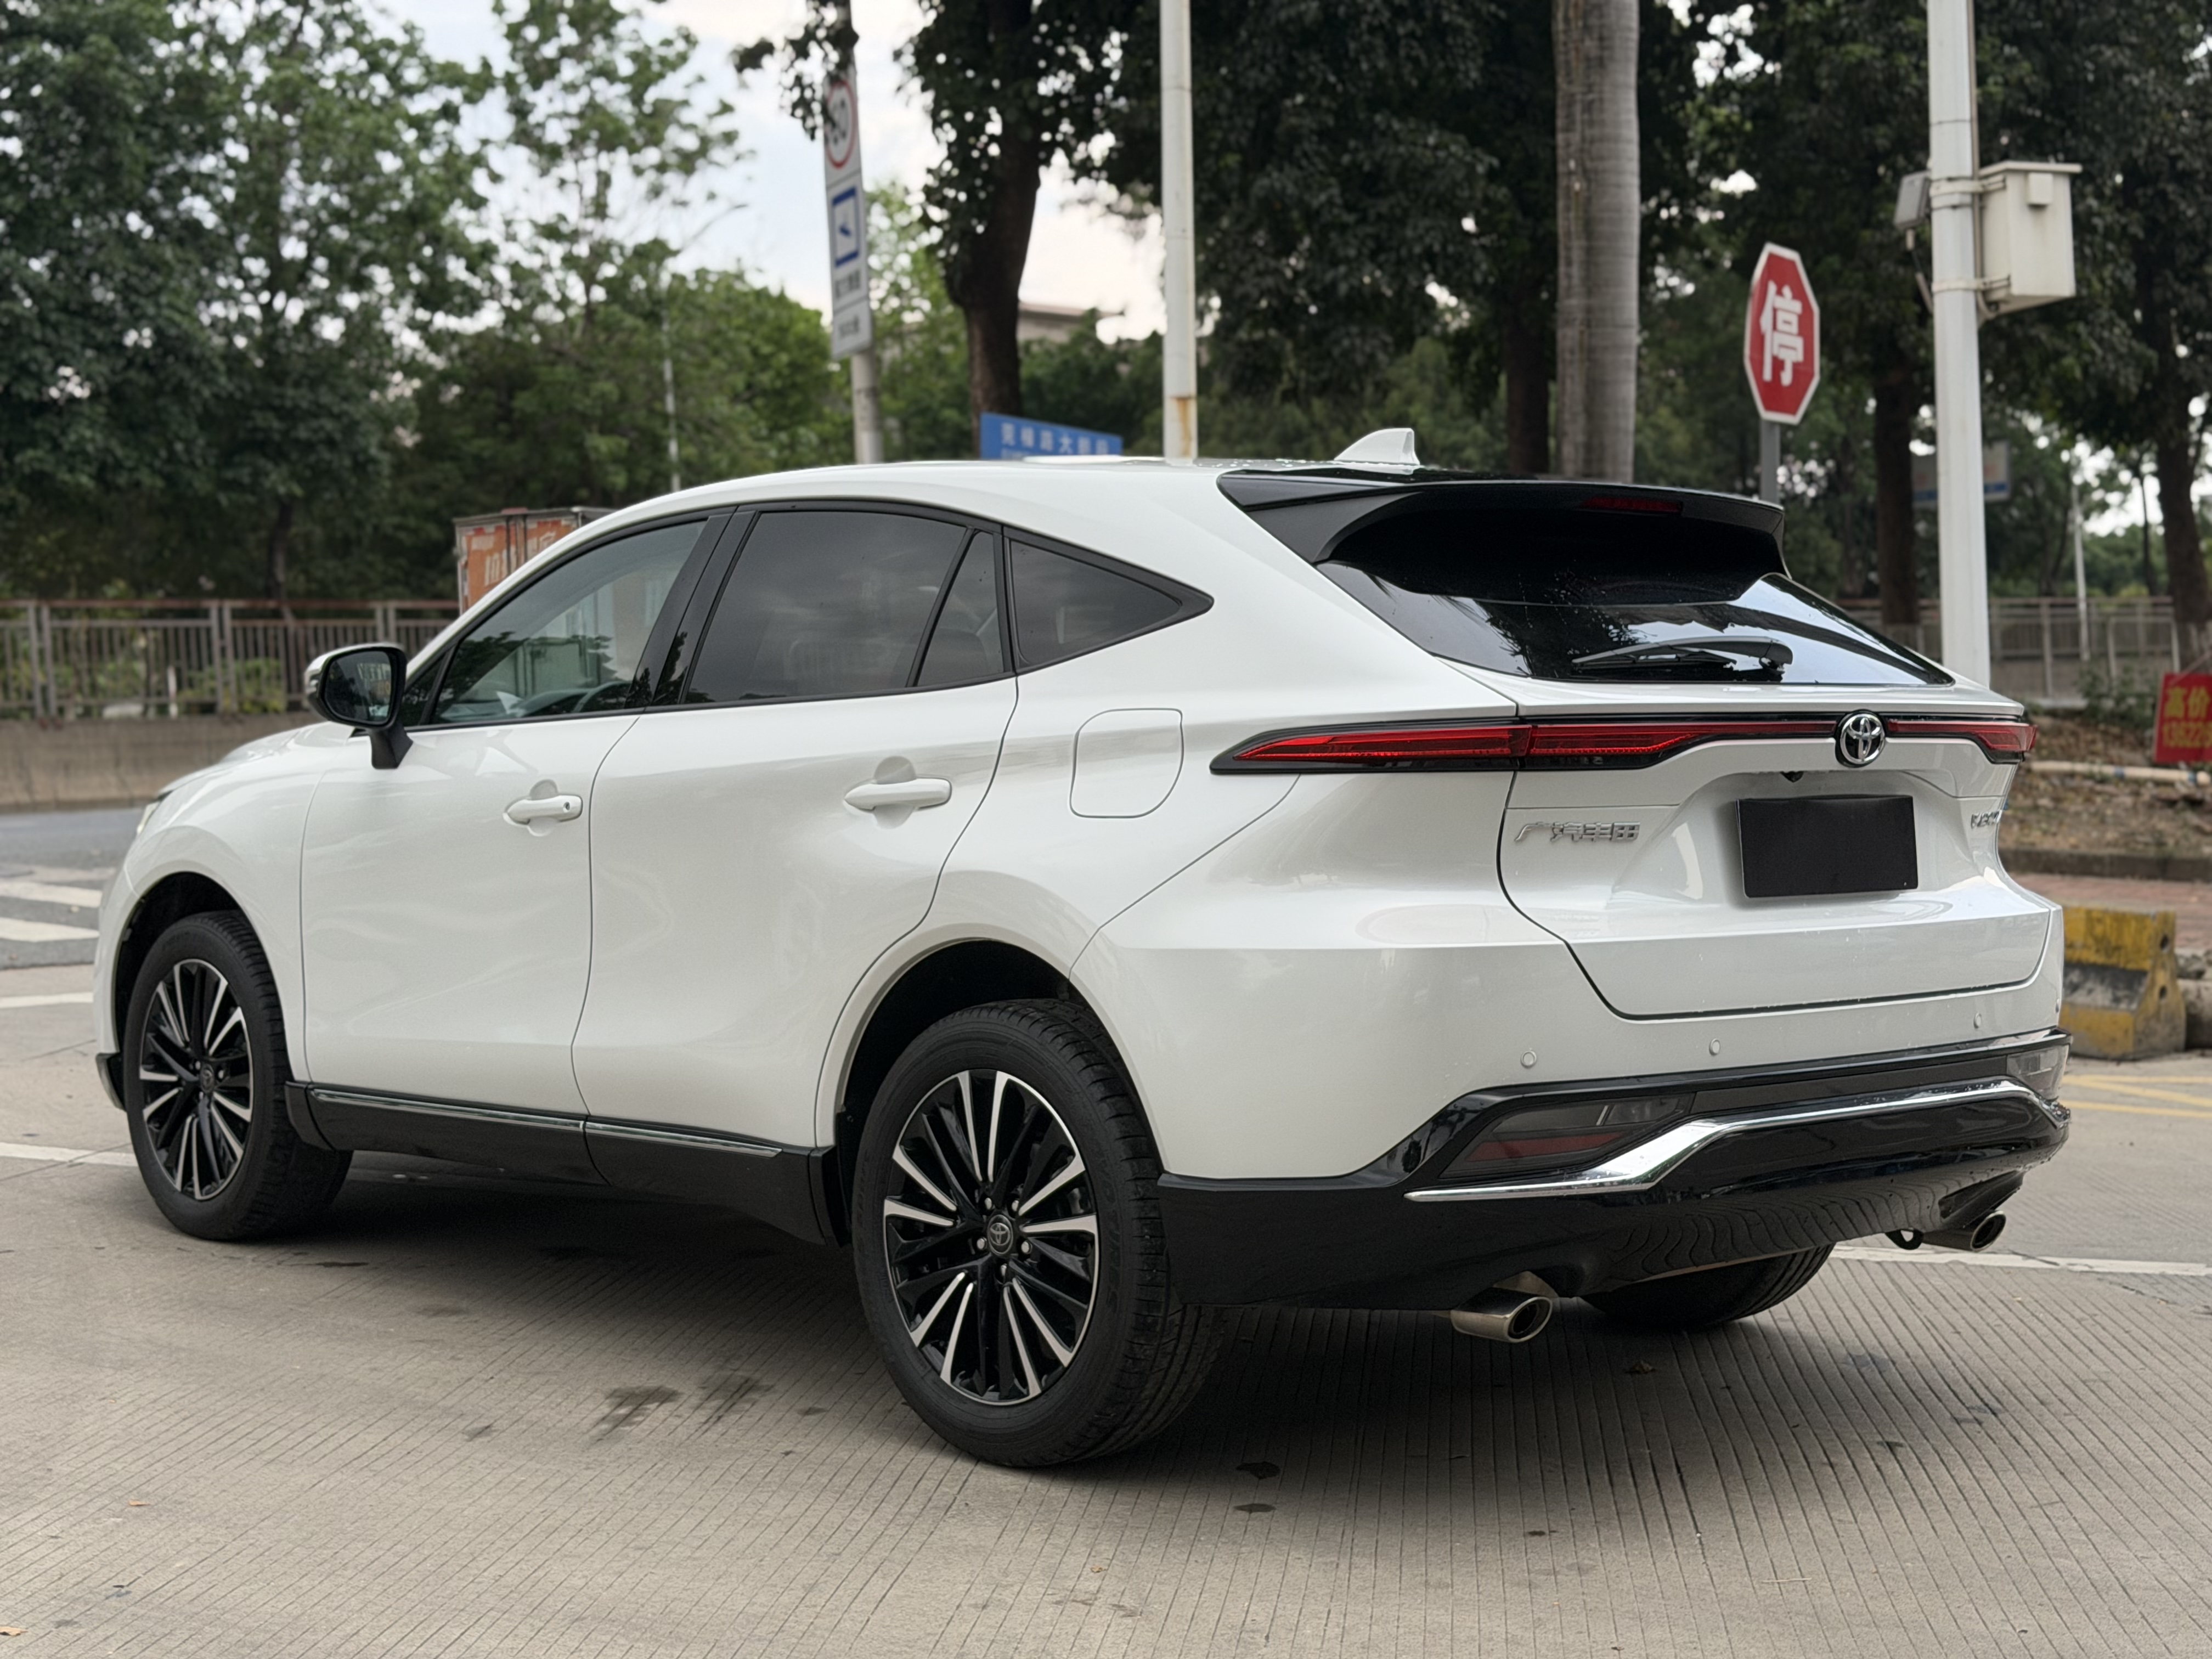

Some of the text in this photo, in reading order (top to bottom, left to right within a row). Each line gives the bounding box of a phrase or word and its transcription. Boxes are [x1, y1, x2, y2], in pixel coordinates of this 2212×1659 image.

[1759, 280, 1804, 387] 停
[1514, 822, 1640, 842] 广汽丰田
